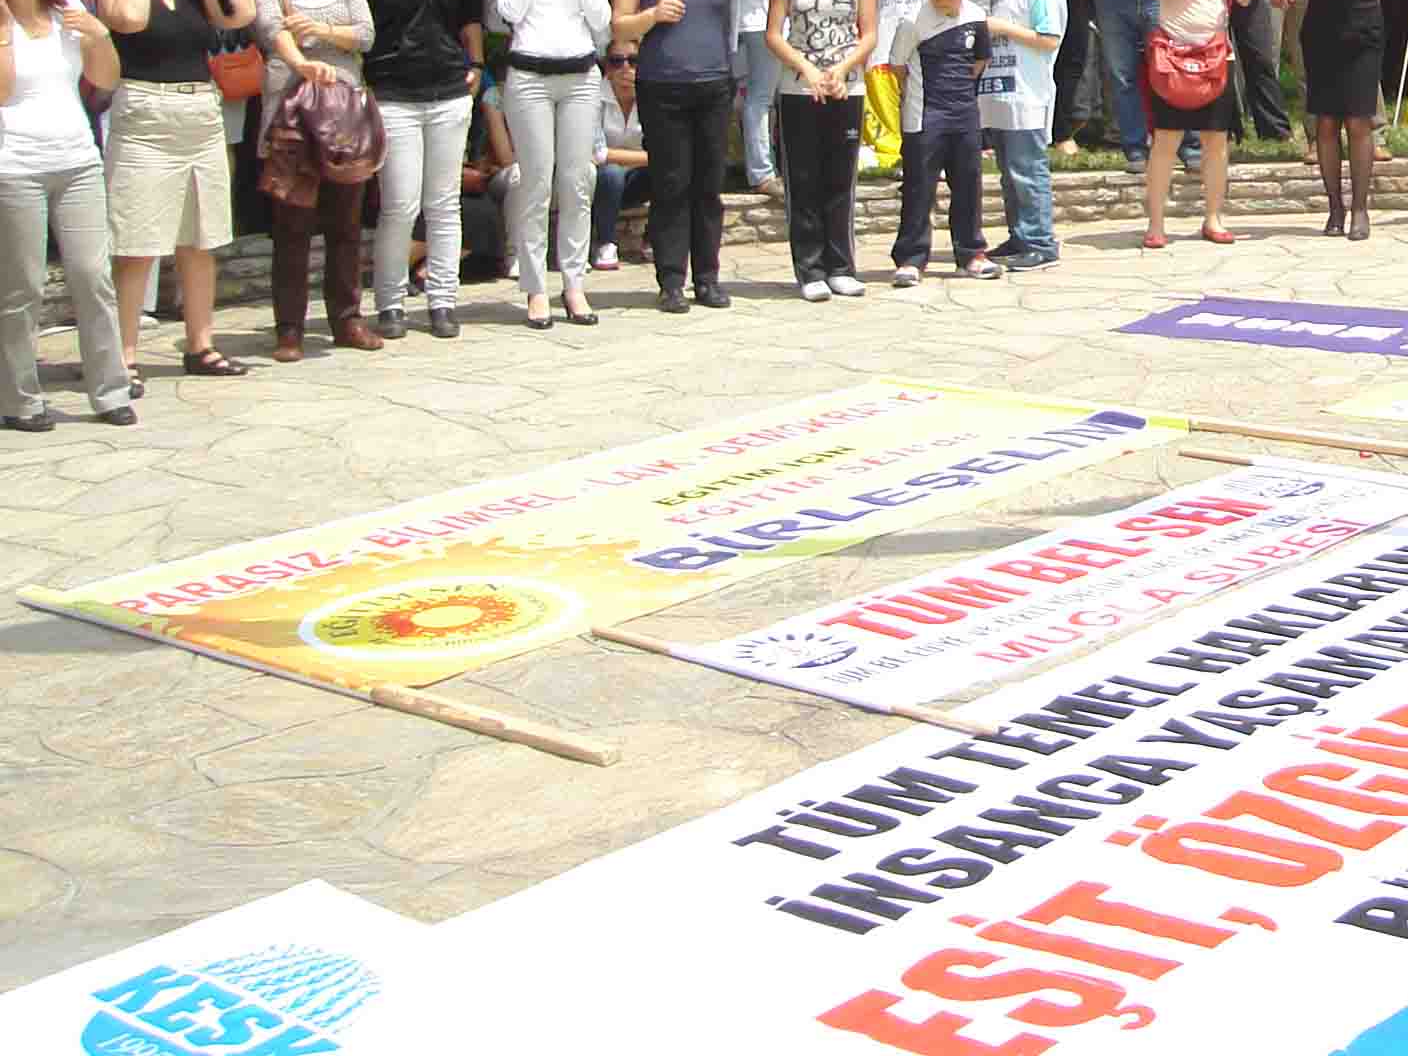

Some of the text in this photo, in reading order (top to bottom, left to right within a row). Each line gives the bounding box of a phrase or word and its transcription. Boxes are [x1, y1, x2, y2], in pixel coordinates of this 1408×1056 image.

[112, 549, 346, 615] PARASIZ
[817, 576, 1031, 640] TÜM
[988, 496, 1273, 585] BEL-SEN
[732, 764, 980, 860] TÜM
[927, 675, 1200, 770] TEMEL
[765, 754, 1200, 935] İNSANCA
[815, 880, 1279, 1056] EŞİT,
